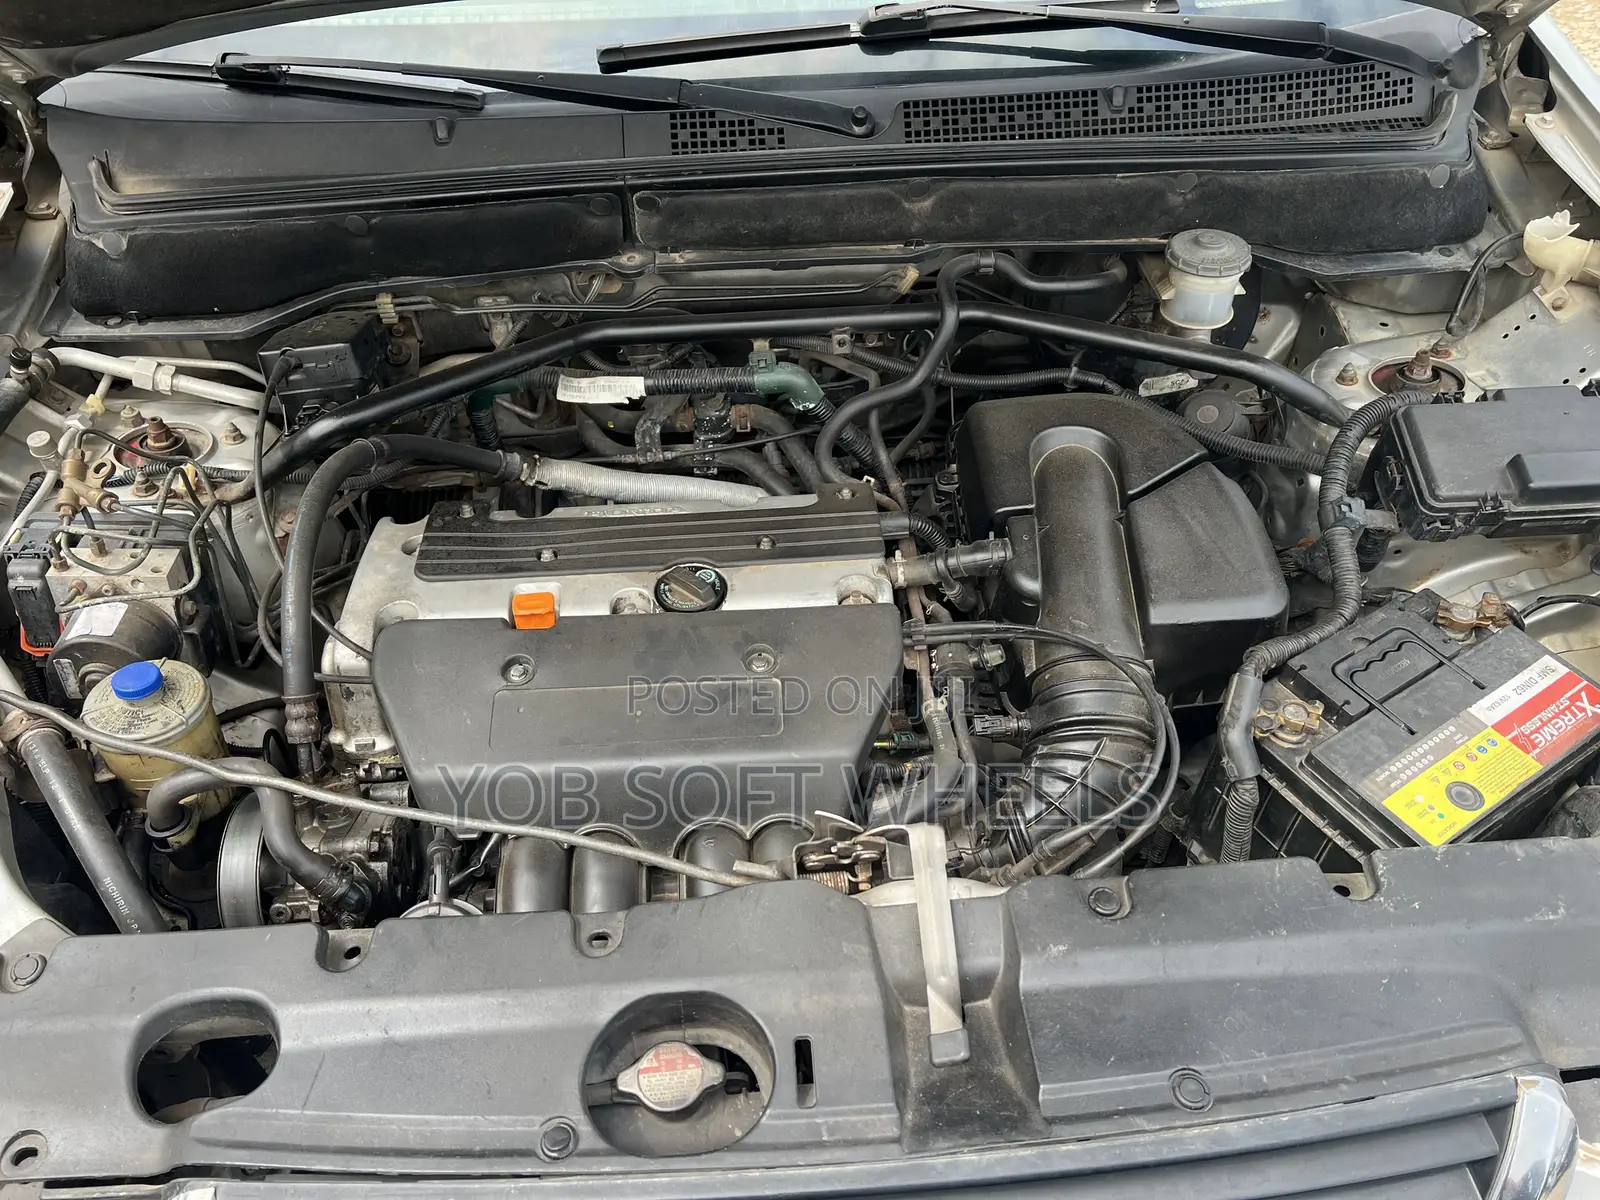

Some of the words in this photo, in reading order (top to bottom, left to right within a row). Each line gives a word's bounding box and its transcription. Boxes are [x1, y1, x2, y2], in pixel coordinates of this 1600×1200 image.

[1512, 676, 1539, 696] DIN62
[1519, 696, 1571, 735] STAINLESS
[1530, 690, 1600, 748] XTREME
[102, 876, 130, 916] NICHIRIN
